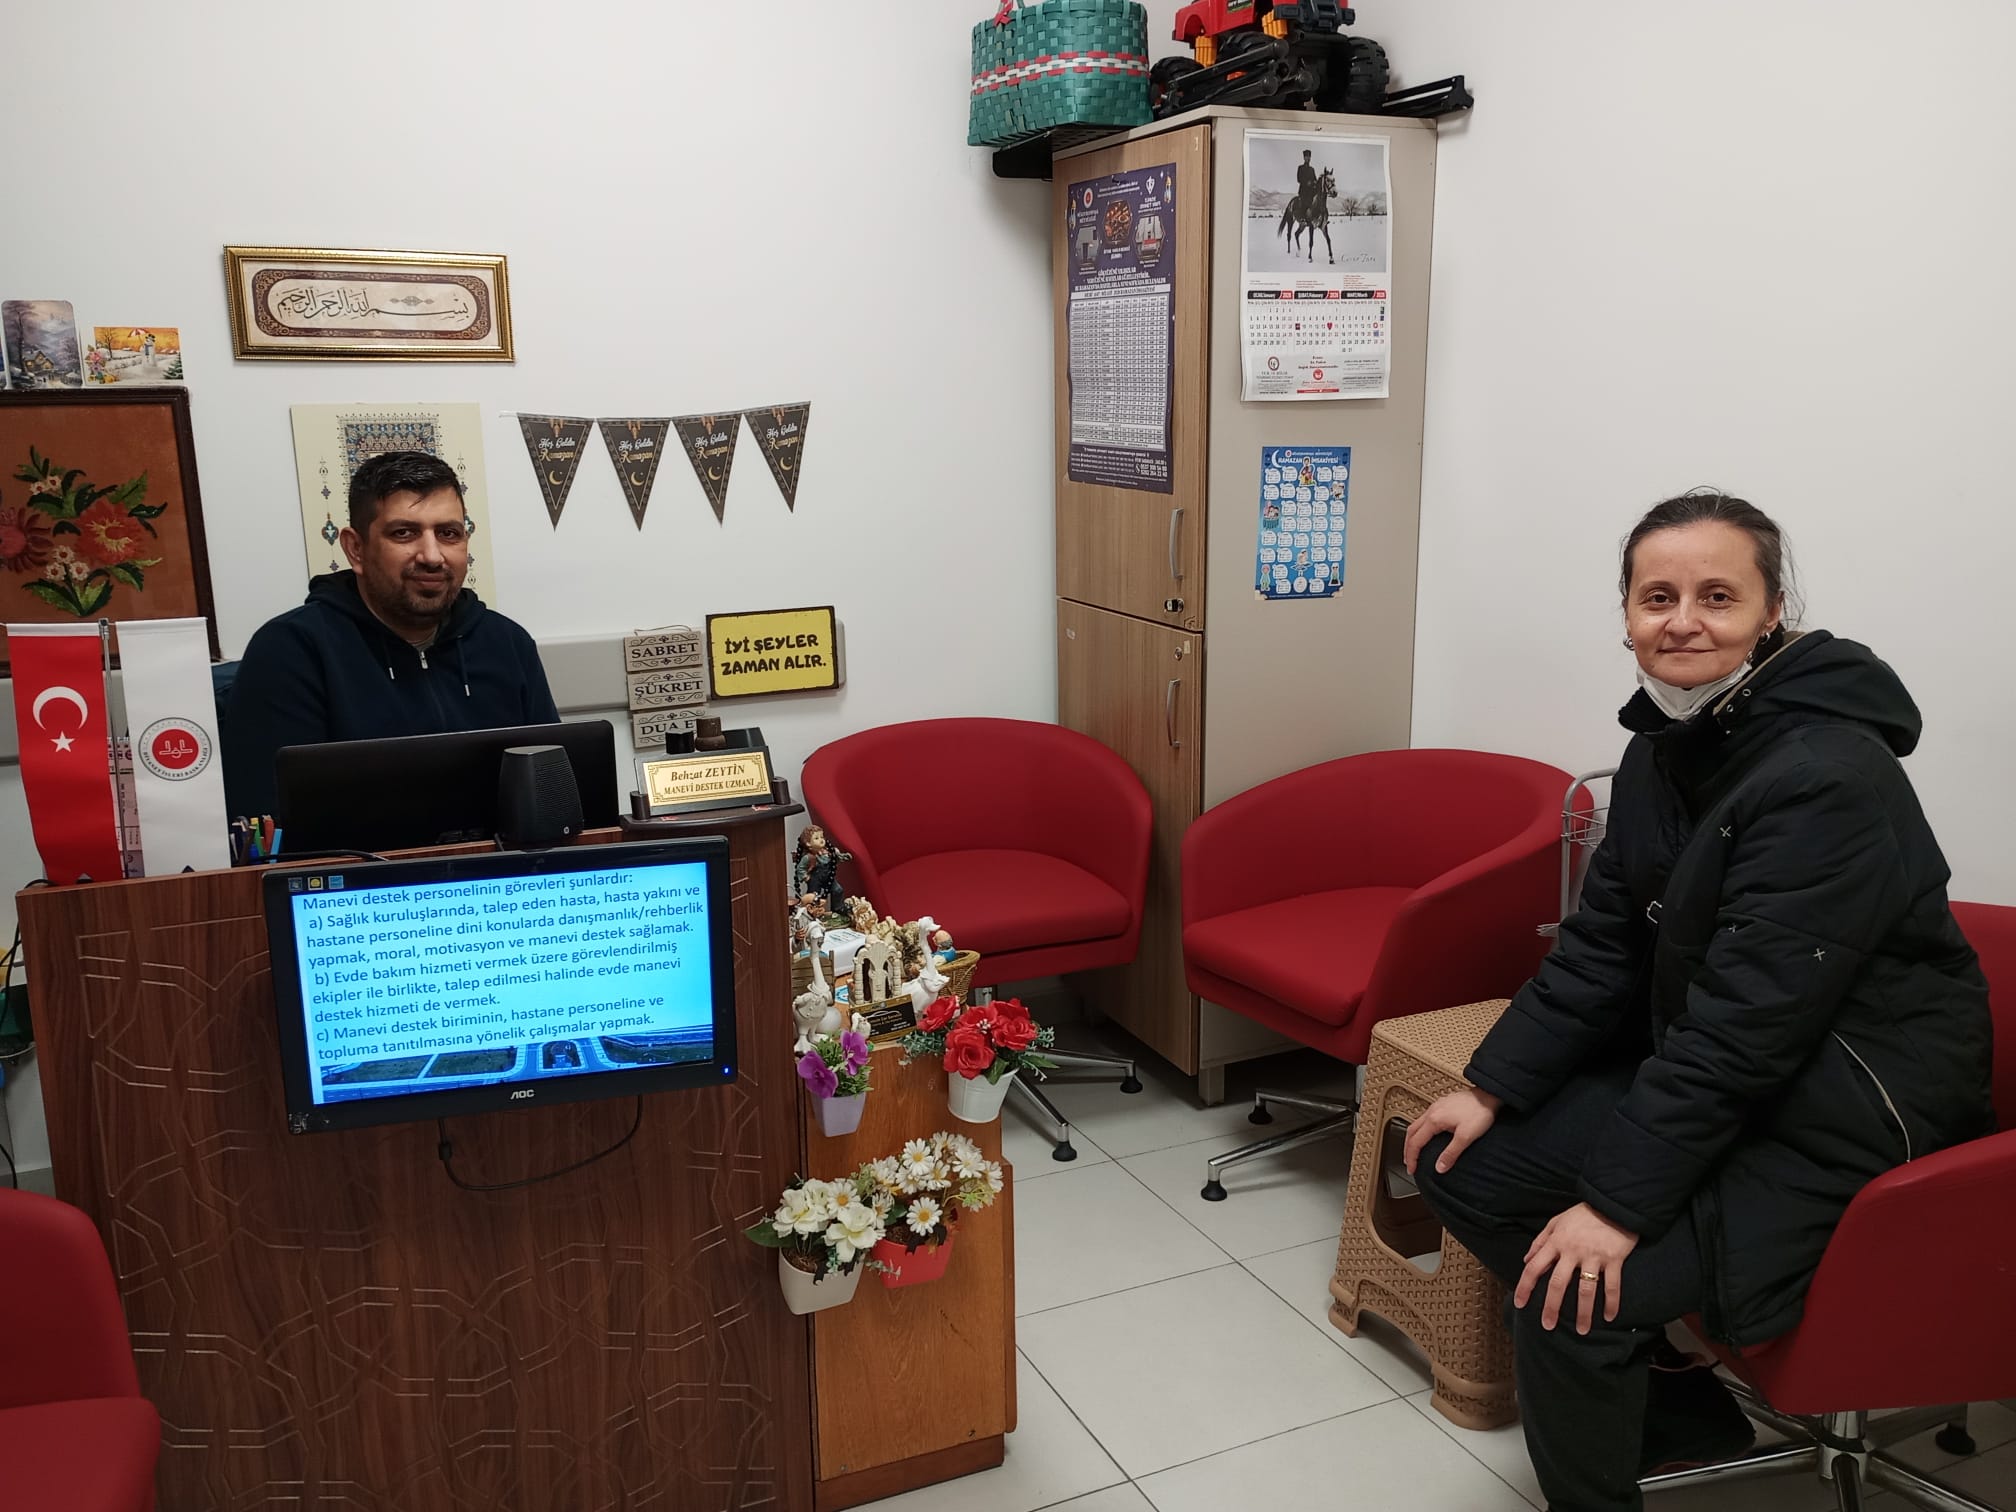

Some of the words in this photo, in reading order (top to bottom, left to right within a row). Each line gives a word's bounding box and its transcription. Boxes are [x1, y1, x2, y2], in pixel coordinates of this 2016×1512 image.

[632, 642, 698, 659] SABRET
[754, 634, 818, 654] ŞEYLER
[721, 658, 780, 675] ZAMAN
[784, 655, 826, 670] ALIR.
[635, 680, 704, 697] ŞÜKRET
[641, 722, 679, 735] DUA
[664, 783, 694, 795] MANEVİ
[695, 781, 723, 792] DESTEK
[725, 778, 754, 788] UZMANI
[671, 770, 703, 782] Behzat
[705, 764, 745, 778] ZEYTİN
[303, 894, 358, 910] Manevi
[362, 890, 410, 905] destek
[414, 883, 500, 904] personelinin
[505, 877, 565, 895] görevleri
[569, 872, 633, 890] şunlardır:
[309, 916, 323, 930] a)
[327, 911, 368, 928] Sağlık
[373, 904, 479, 923] kuruluşlarında,
[483, 899, 518, 914] talep
[522, 897, 556, 910] eden
[560, 893, 600, 907] hasta,
[604, 889, 640, 903] hasta
[644, 886, 681, 902] yakını
[685, 886, 700, 896] ve
[307, 932, 364, 948] hastane
[369, 924, 453, 945] personeline
[457, 921, 482, 935] dini
[487, 915, 554, 932] konularda
[559, 902, 704, 925] danışmanlık/rehberlik
[308, 950, 370, 969] yapmak,
[375, 946, 420, 961] moral,
[425, 940, 504, 957] motivasyon
[508, 938, 524, 948] ve
[528, 931, 578, 946] manevi
[582, 926, 626, 942] destek
[629, 921, 694, 938] sağlamak.
[315, 972, 329, 986] b)
[334, 969, 368, 983] Evde
[372, 965, 416, 980] bakım
[420, 960, 472, 975] hizmeti
[476, 954, 528, 969] vermek
[531, 952, 568, 965] üzere
[571, 941, 677, 963] görevlendirilmiş
[313, 990, 362, 1006] ekipler
[366, 987, 383, 999] ile
[387, 982, 440, 997] birlikte,
[445, 976, 480, 992] talep
[484, 971, 540, 987] edilmesi
[544, 966, 594, 981] halinde
[598, 962, 629, 975] evde
[633, 958, 681, 972] manevi
[315, 1007, 362, 1023] destek
[366, 1002, 419, 1018] hizmeti
[423, 999, 440, 1011] de
[444, 994, 500, 1009] vermek.
[316, 1029, 329, 1042] c)
[334, 1023, 387, 1040] Manevi
[391, 1016, 437, 1032] destek
[442, 1012, 507, 1028] biriminin,
[511, 1006, 564, 1021] hastane
[568, 997, 646, 1017] personeline
[649, 996, 664, 1006] ve
[319, 1044, 378, 1060] topluma
[383, 1034, 473, 1052] tanıtılmasına
[477, 1027, 525, 1045] yönelik
[529, 1022, 595, 1039] çalışmalar
[600, 1013, 654, 1031] yapmak.
[510, 1089, 534, 1100] AOC
